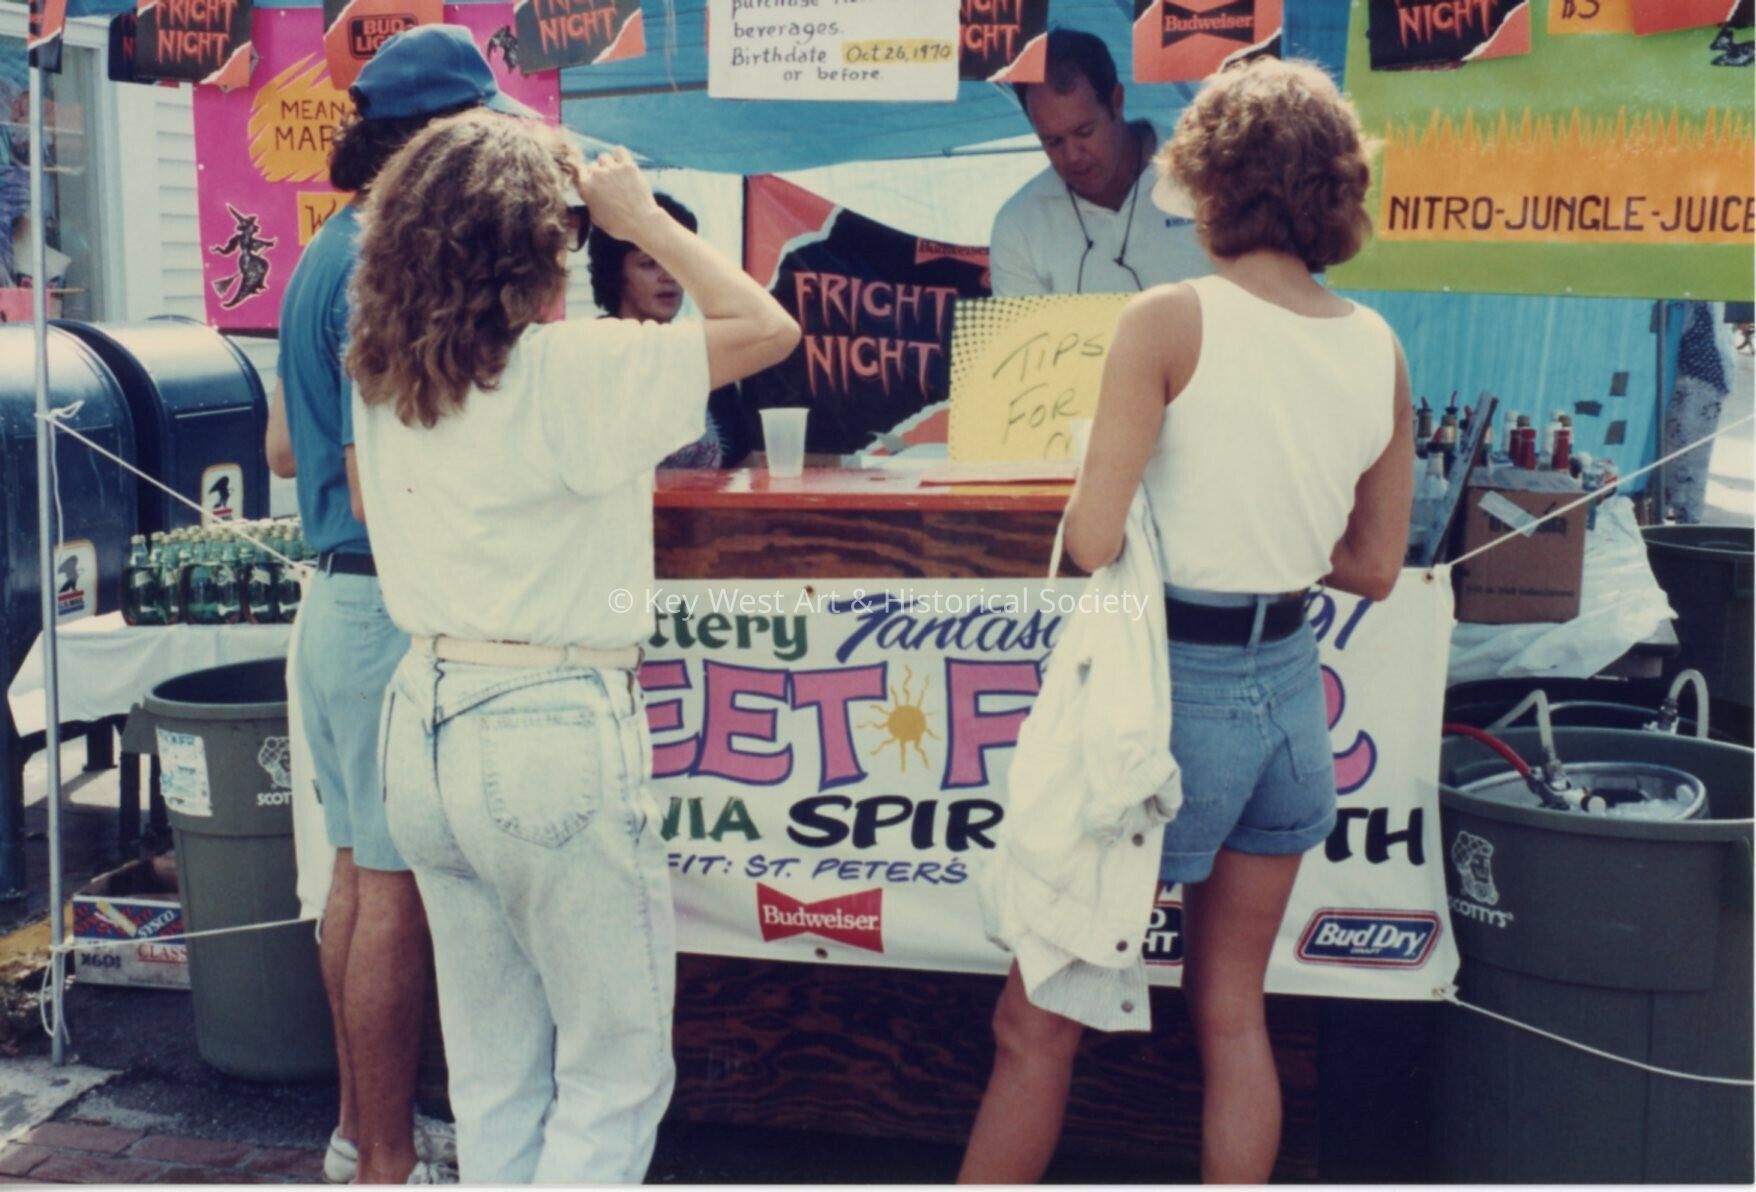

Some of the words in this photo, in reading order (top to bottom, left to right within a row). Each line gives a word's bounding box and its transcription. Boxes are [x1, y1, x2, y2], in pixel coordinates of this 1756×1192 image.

[540, 7, 617, 56] NIGHT
[1165, 13, 1255, 32] Budweiser
[1398, 0, 1498, 49] NIGHT
[157, 29, 230, 66] NIGHT
[731, 47, 827, 67] Birthdate
[845, 44, 879, 64] Oct
[783, 69, 802, 82] or
[793, 271, 960, 341] FRIGHT
[801, 335, 944, 401] NIGHT
[993, 331, 1104, 382] TIPS
[1001, 382, 1081, 446] FOR
[745, 854, 801, 878] ST.
[762, 905, 880, 931] Budweiser
[1315, 922, 1378, 948] Bud
[1371, 924, 1427, 957] Dry
